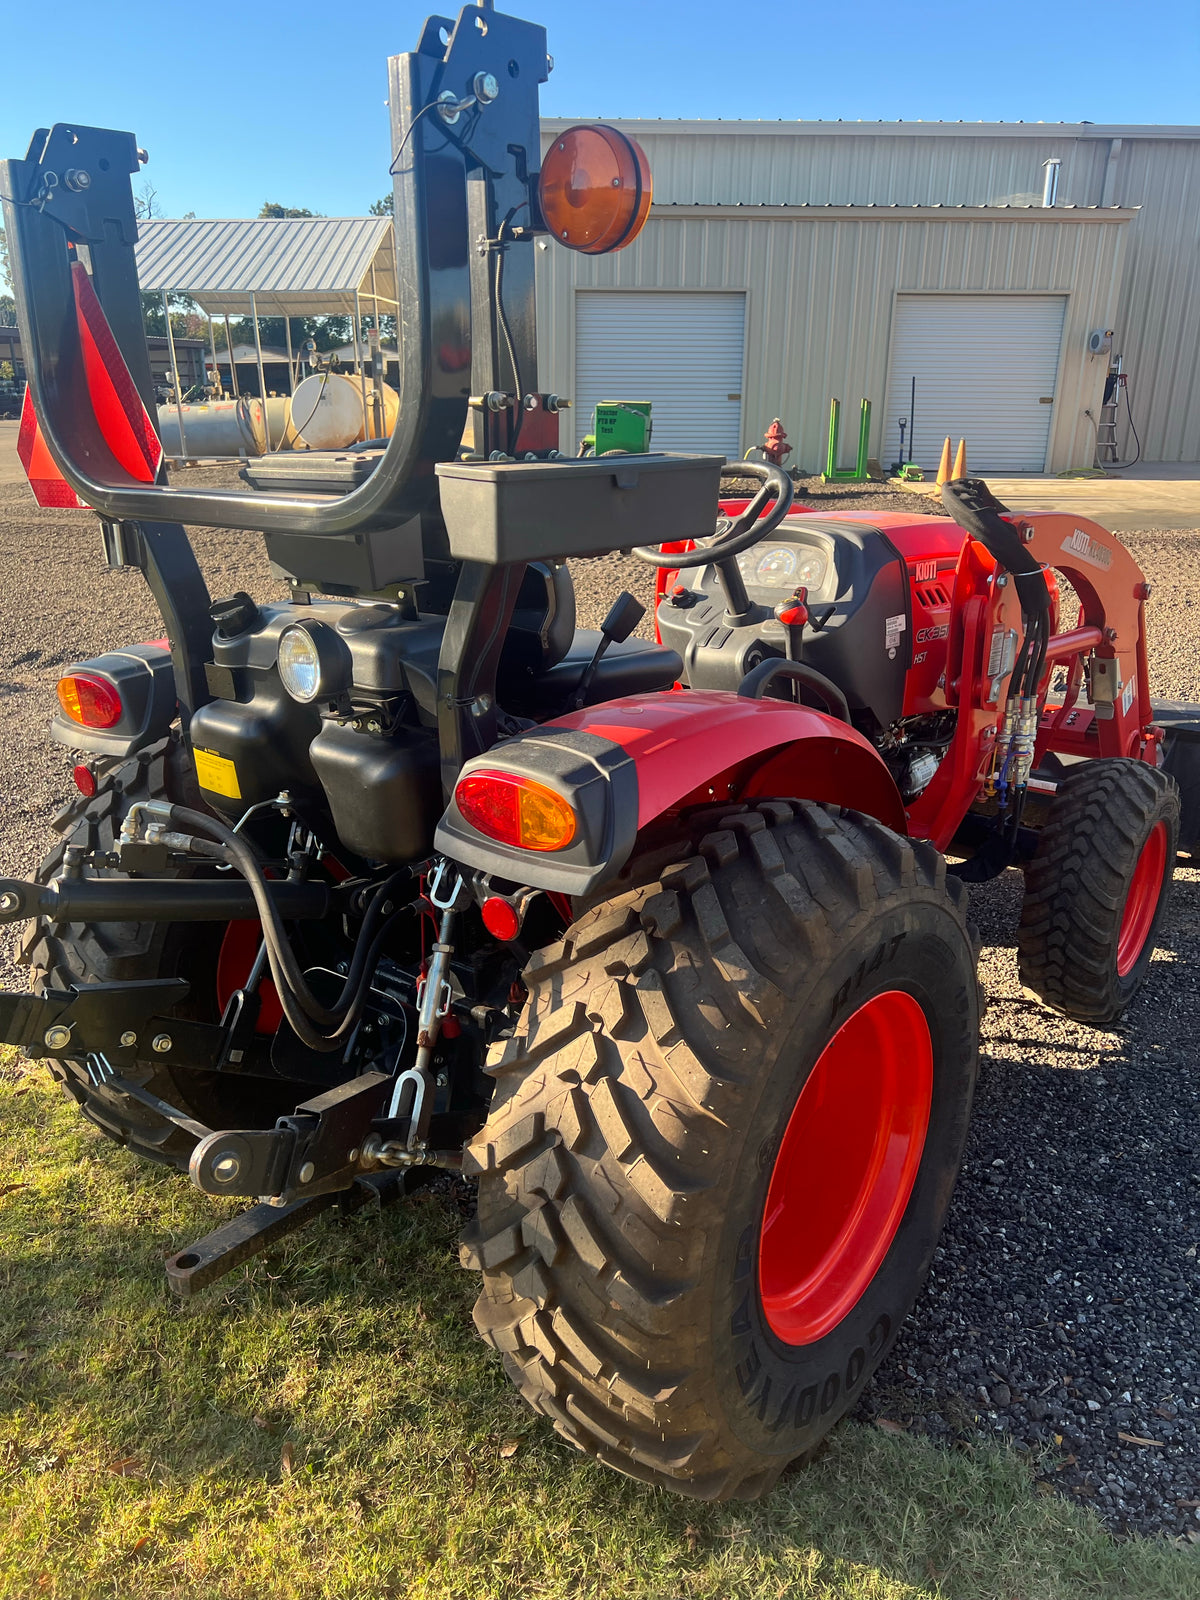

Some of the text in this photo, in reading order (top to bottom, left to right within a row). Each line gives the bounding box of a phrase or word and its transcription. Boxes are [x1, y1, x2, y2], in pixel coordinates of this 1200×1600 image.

[1070, 528, 1091, 555] KIOTI
[915, 561, 937, 583] KIOTI
[913, 651, 928, 665] HST
